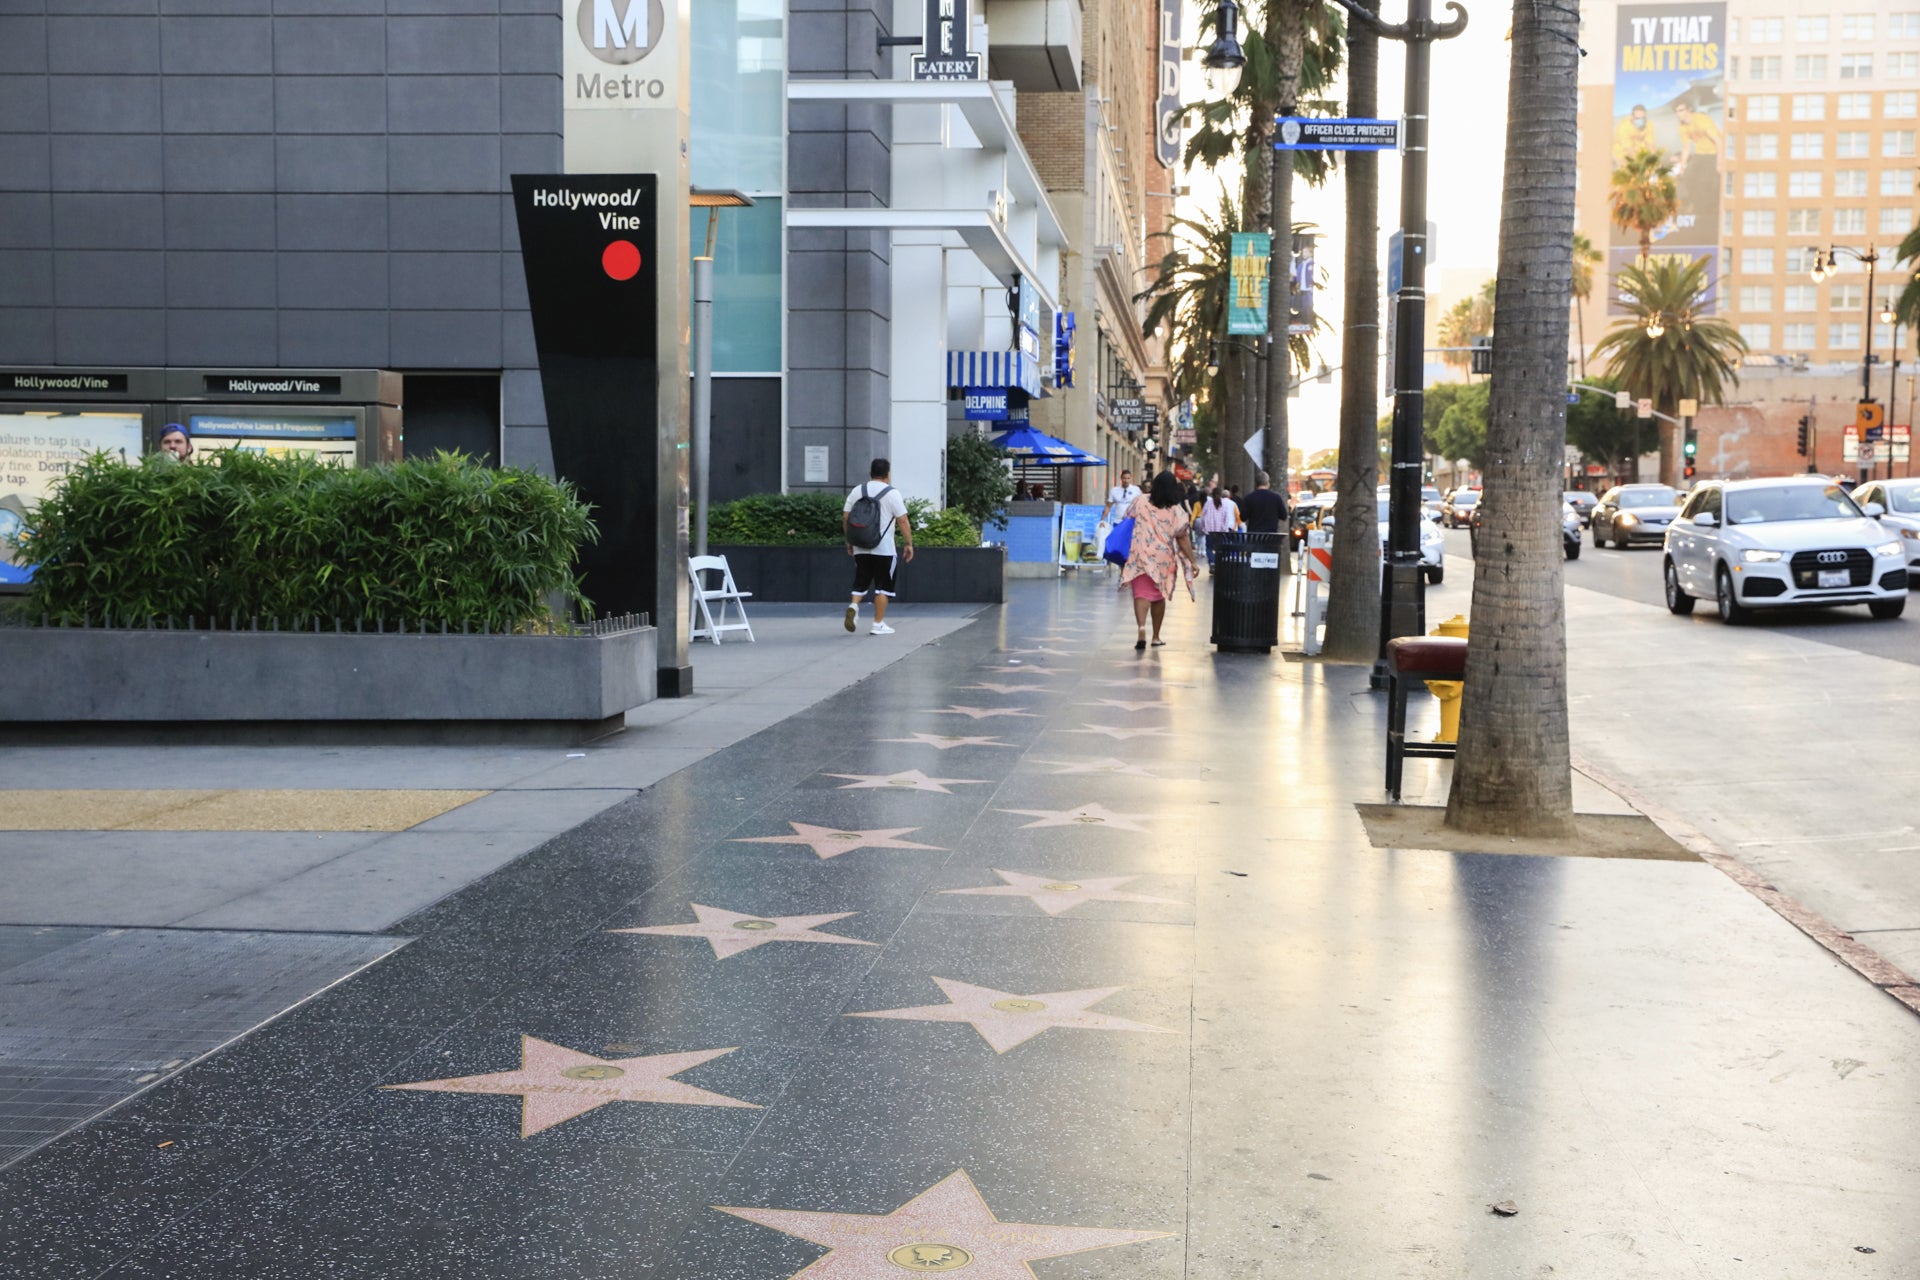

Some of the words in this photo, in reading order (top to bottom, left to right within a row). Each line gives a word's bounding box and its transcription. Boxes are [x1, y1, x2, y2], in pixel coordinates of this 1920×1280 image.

[1630, 17, 1658, 45] TV
[1660, 15, 1712, 44] THAT
[1622, 42, 1718, 71] MATTERS
[918, 61, 974, 74] EATERY
[576, 73, 664, 99] Metro
[1304, 125, 1333, 135] OFFICER
[1334, 125, 1356, 135] CLYDE
[1357, 125, 1395, 136] PRITCHETT
[533, 188, 641, 210] Hollywood/
[599, 212, 641, 230] Vine
[14, 376, 109, 390] Hollywood/Vine
[228, 379, 321, 394] Hollywood/Vine
[965, 395, 1007, 409] DELPHINE
[1116, 399, 1140, 407] WOOD
[1120, 407, 1142, 416] VINE
[34, 435, 46, 446] to
[49, 436, 68, 449] tap
